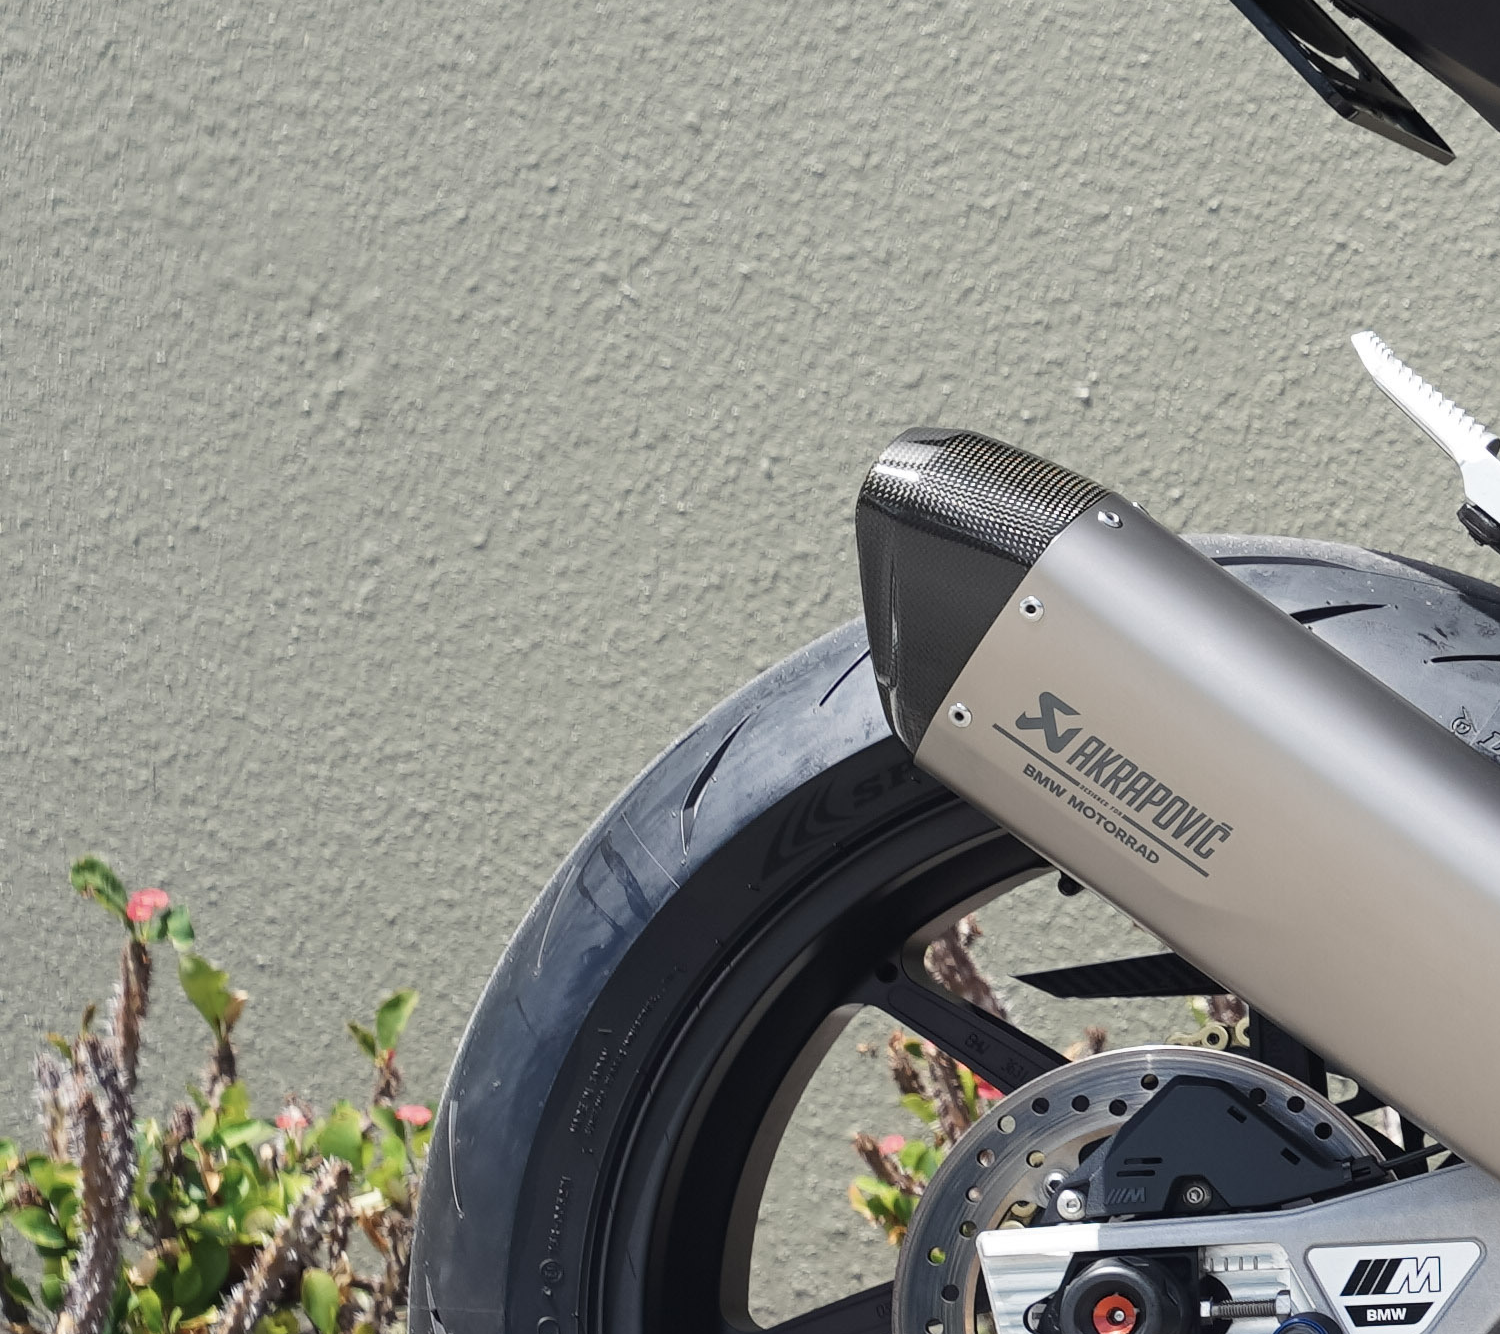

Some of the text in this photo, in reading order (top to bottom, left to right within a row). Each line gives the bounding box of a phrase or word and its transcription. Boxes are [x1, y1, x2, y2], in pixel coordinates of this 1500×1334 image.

[1022, 763, 1160, 864] BMW MOTORRAD
[1066, 735, 1234, 859] AKRAPOVIČ
[1366, 1307, 1407, 1322] BMW
